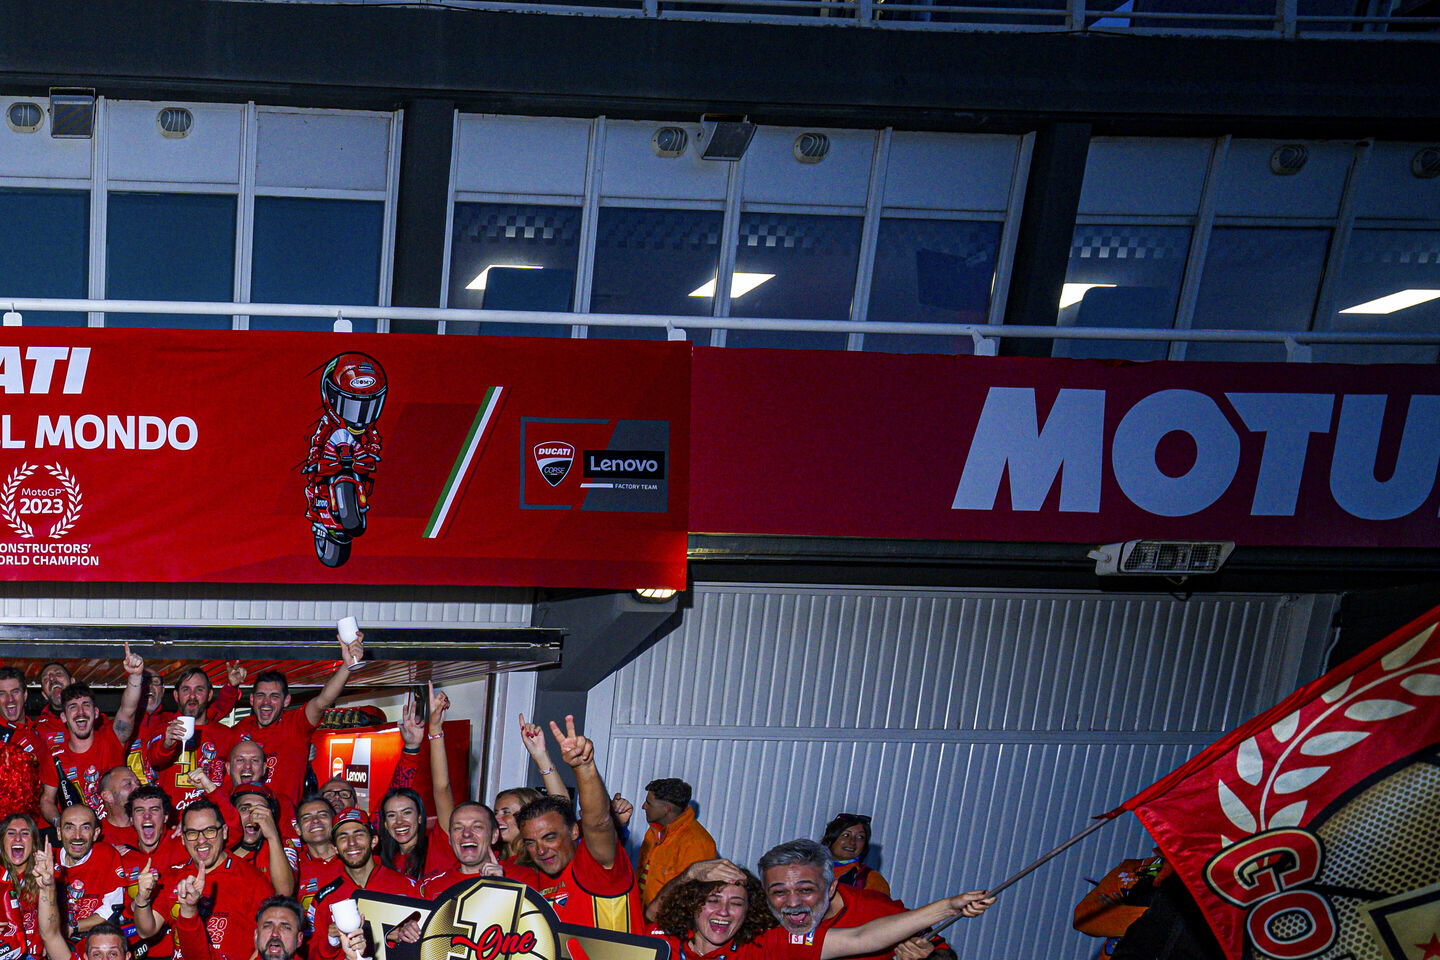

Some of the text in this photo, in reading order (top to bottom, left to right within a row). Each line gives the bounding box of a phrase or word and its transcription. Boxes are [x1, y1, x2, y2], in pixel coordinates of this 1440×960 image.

[34, 415, 198, 451] MONDO
[538, 447, 570, 455] DUCATI
[951, 386, 1440, 521] MOTU
[590, 455, 658, 472] Lenovo
[19, 498, 64, 514] 2023
[33, 555, 100, 566] CHAMPION
[346, 769, 367, 782] Lenovo
